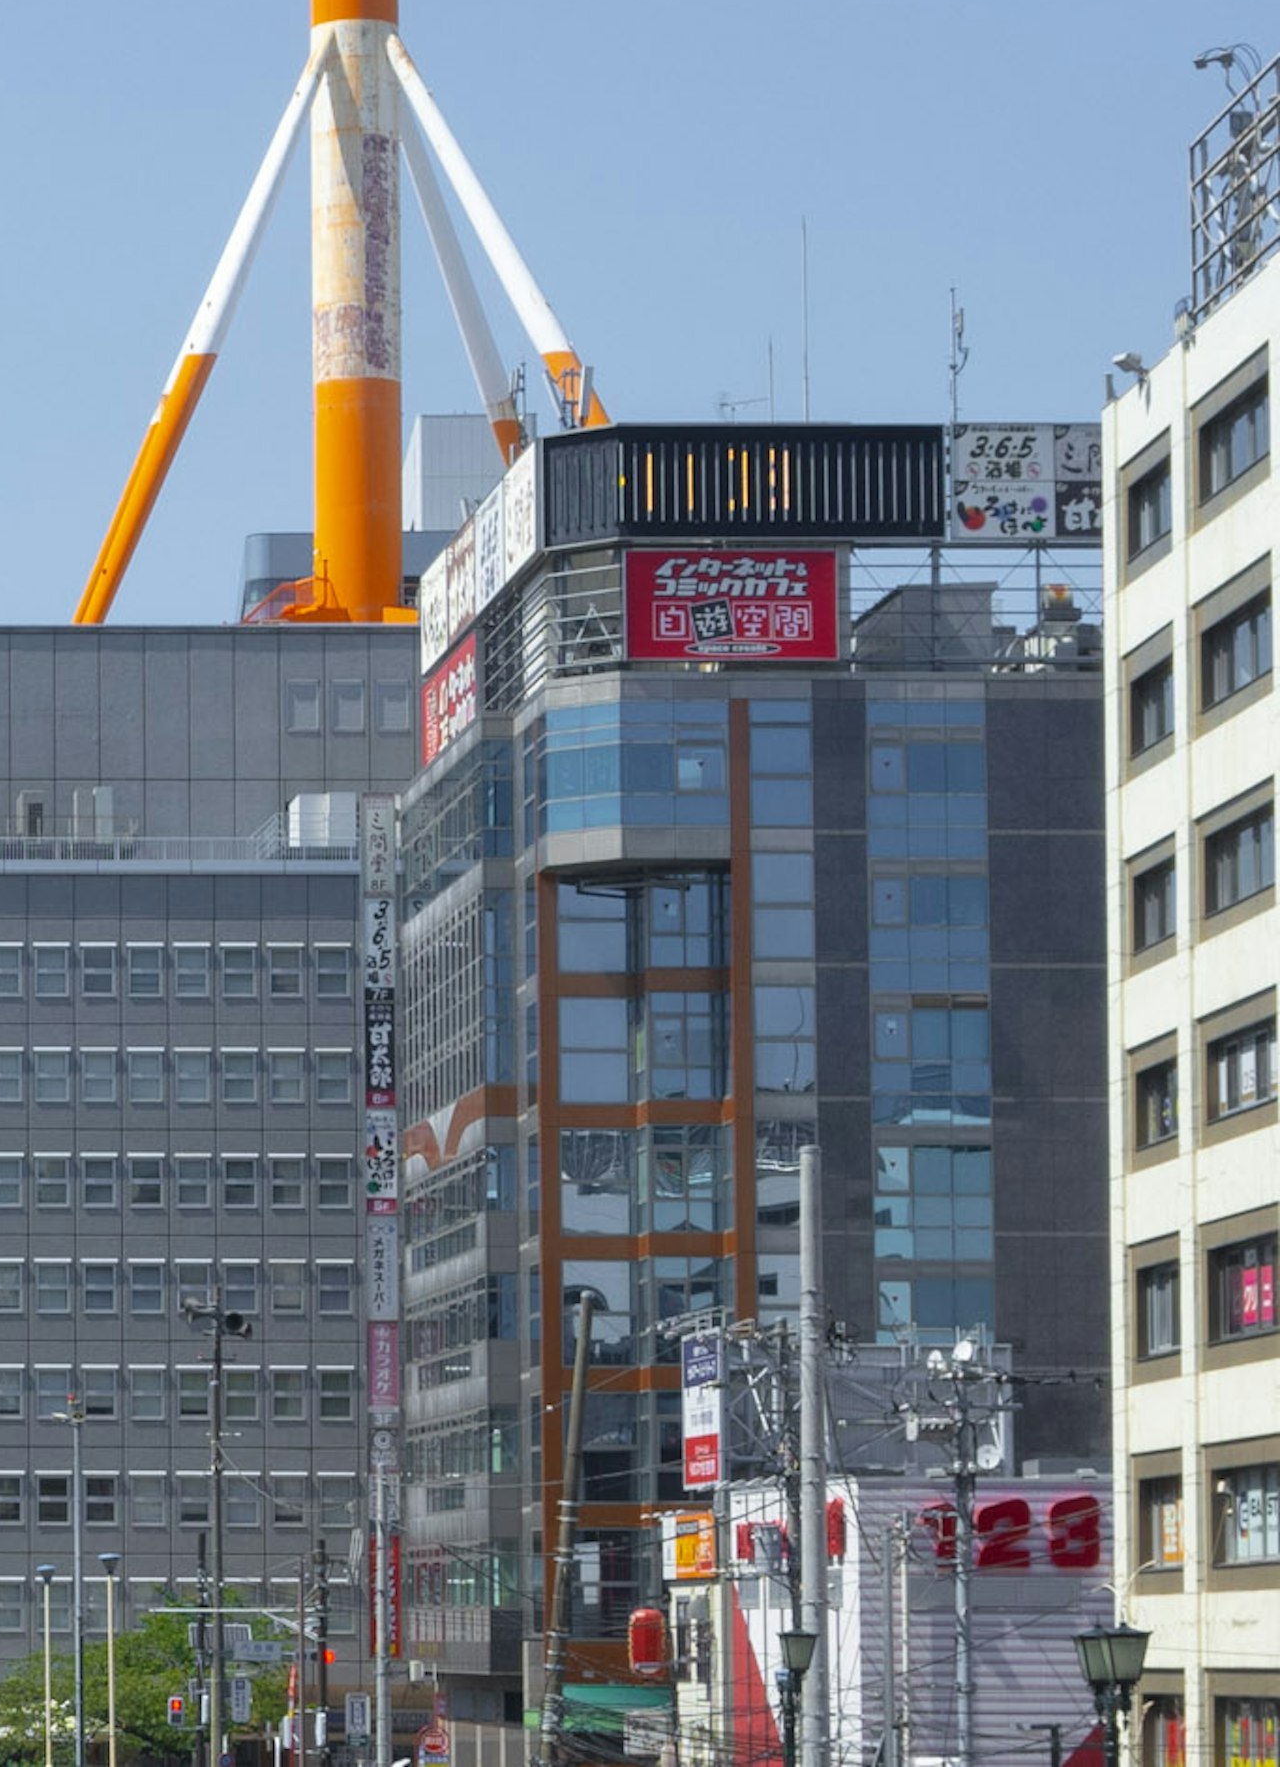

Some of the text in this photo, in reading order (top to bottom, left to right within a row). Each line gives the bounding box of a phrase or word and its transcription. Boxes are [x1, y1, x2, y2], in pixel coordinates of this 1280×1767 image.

[653, 577, 809, 598] コミックカフェ
[659, 602, 808, 639] 自遊空間
[375, 1340, 392, 1395] カラオケ
